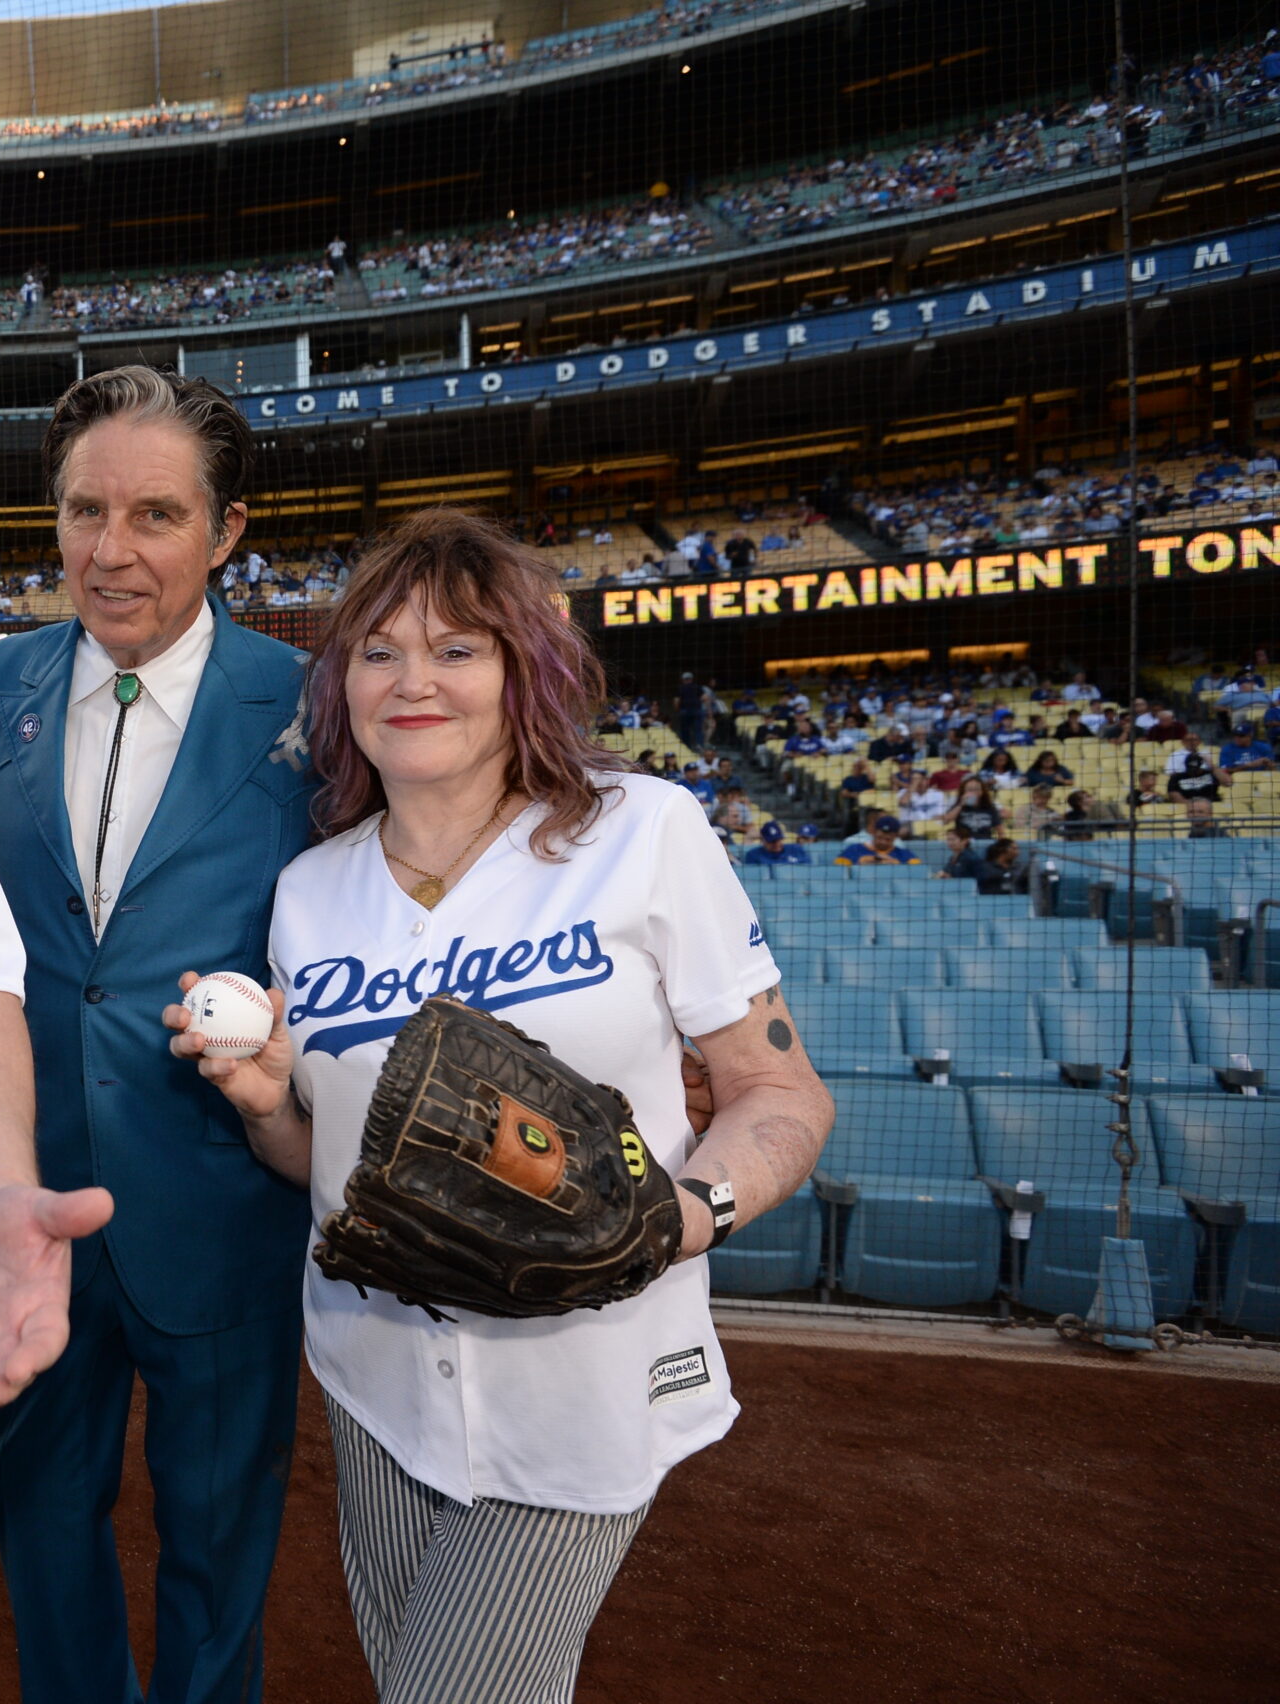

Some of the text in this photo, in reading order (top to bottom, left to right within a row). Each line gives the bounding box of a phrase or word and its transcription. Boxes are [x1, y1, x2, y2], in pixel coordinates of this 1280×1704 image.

[445, 372, 503, 398] TO
[556, 325, 807, 383] DODGER
[870, 241, 1232, 332] STADIUM
[603, 543, 1108, 627] ENTERTAINMENT
[288, 919, 610, 1030] Dodgers
[657, 1358, 700, 1380] Majestic
